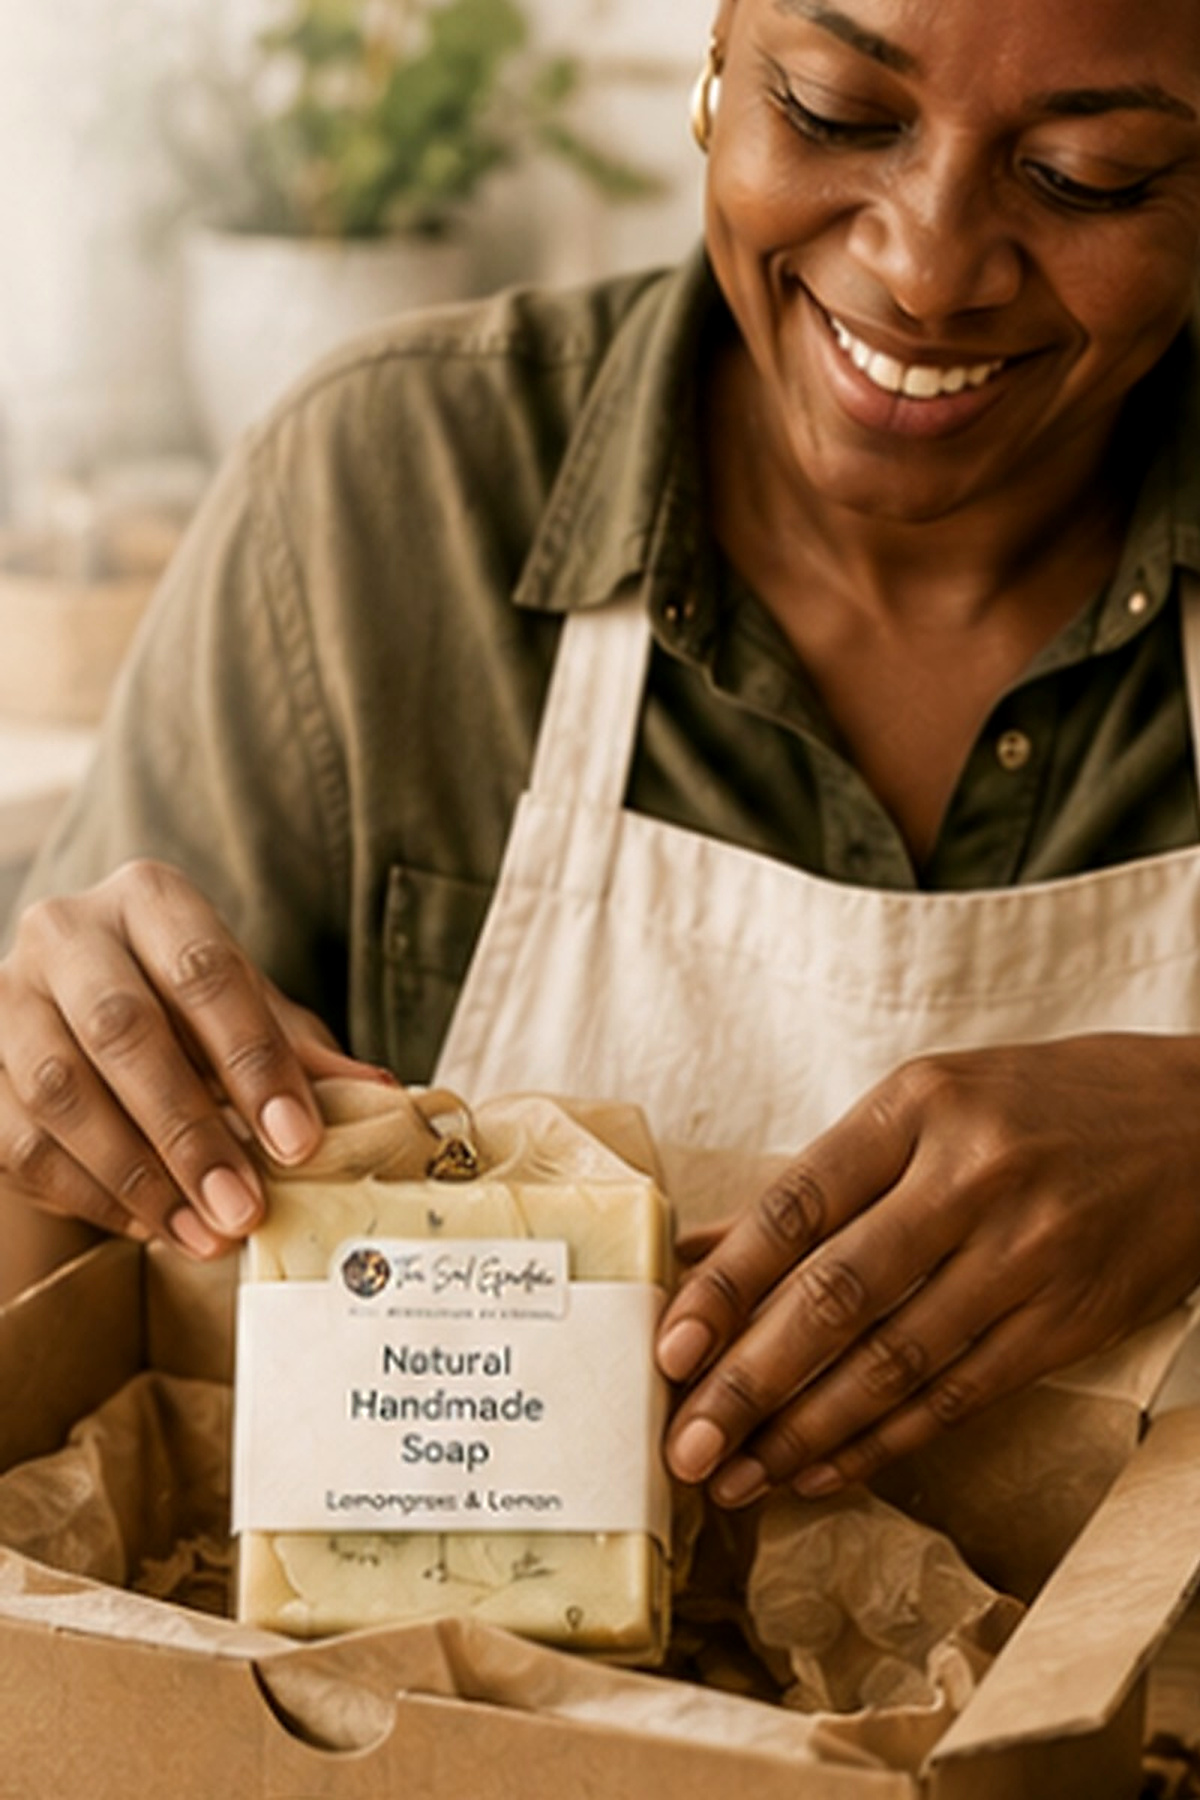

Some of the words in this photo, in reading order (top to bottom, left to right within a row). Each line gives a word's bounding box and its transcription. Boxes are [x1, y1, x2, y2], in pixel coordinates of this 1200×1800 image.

[382, 1345, 511, 1376] Natural
[350, 1390, 545, 1421] Handmade
[401, 1434, 490, 1471] Soap
